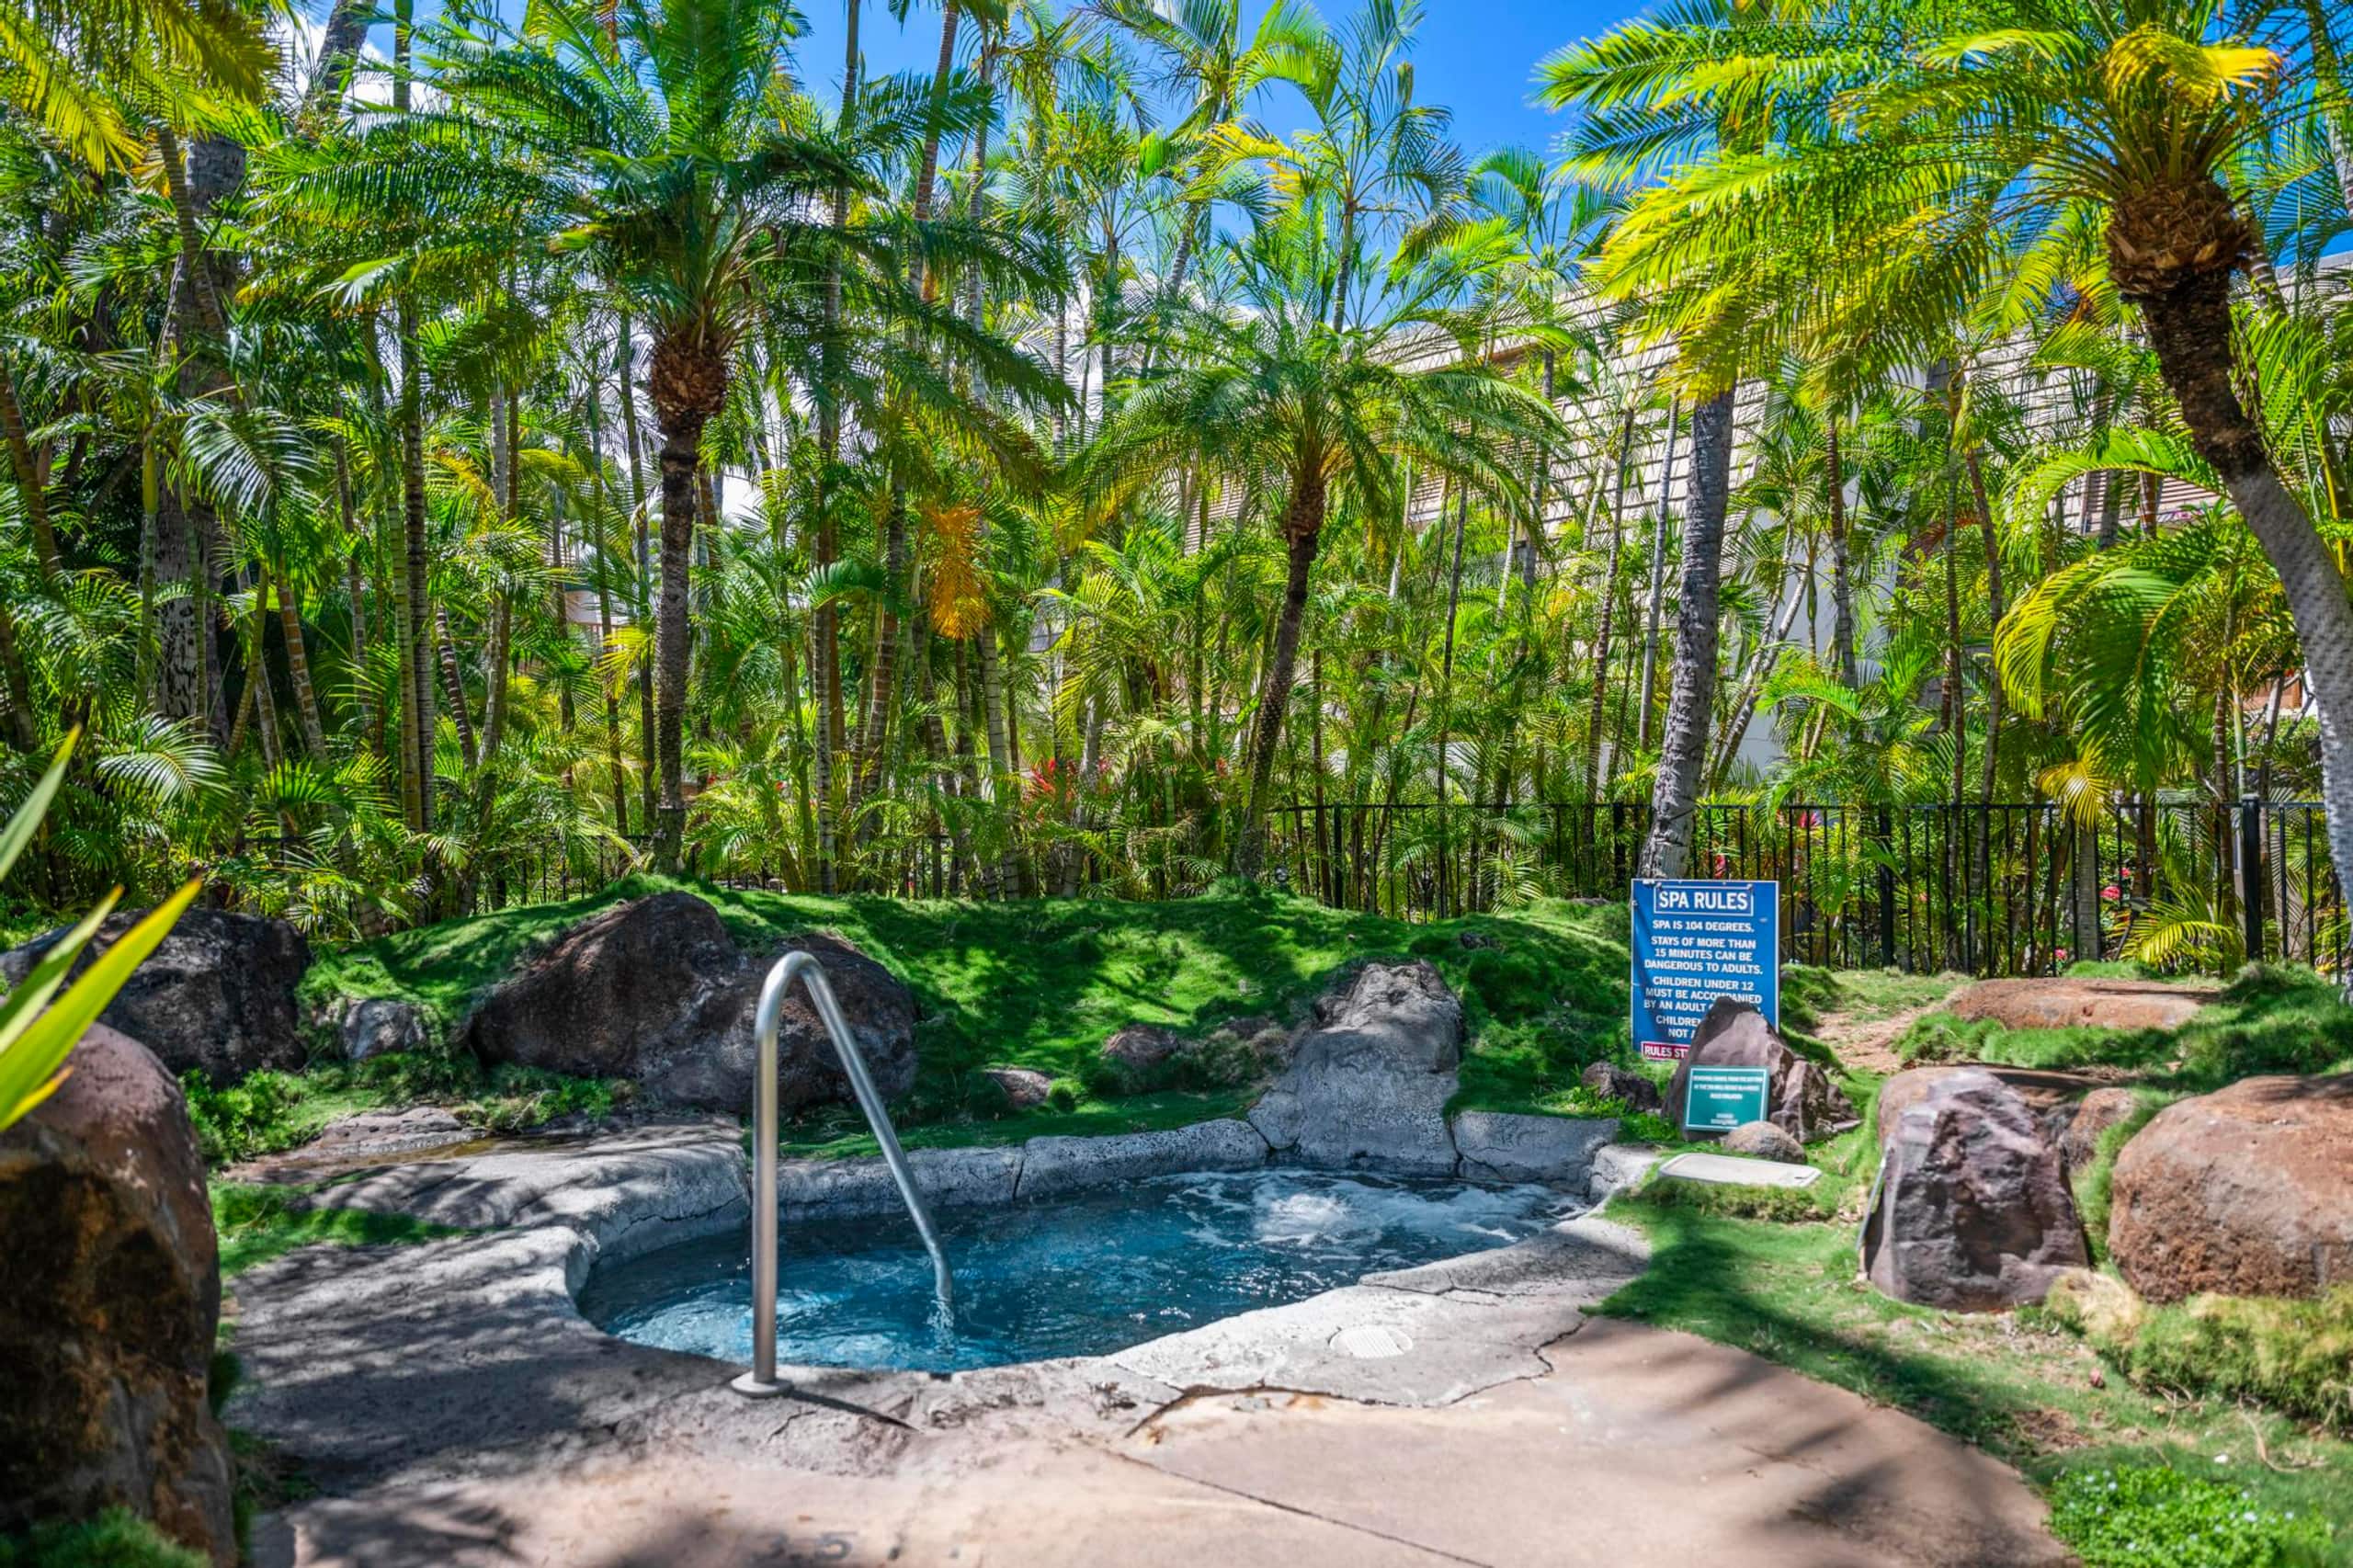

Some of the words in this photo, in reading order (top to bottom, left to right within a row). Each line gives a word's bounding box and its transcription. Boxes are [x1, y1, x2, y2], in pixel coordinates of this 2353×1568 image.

[1659, 892, 1689, 908] SPA
[1694, 892, 1747, 910] RULES
[1653, 920, 1671, 930] SPA
[1673, 921, 1683, 930] IS
[1686, 921, 1701, 930] 104
[1705, 922, 1755, 933] DEGREES.
[1651, 936, 1679, 947] STAYS
[1682, 937, 1694, 947] OF
[1697, 937, 1726, 948] MORE
[1729, 938, 1756, 949] THAN
[1655, 949, 1666, 958] 15
[1669, 949, 1712, 960] MINUTES
[1715, 950, 1736, 960] CAN
[1739, 951, 1753, 961] BE
[1644, 959, 1703, 971] DANGEROUS
[1707, 961, 1720, 972] TO
[1722, 962, 1763, 974] ADULTS.
[1653, 976, 1701, 987] CHILDREN
[1704, 979, 1738, 990] UNDER
[1742, 981, 1754, 992] 12
[1645, 987, 1673, 998] MUST
[1676, 989, 1688, 999] BE
[1643, 999, 1656, 1008] BY
[1659, 1000, 1673, 1010] AN
[1675, 1001, 1706, 1012] ADULT
[1668, 1028, 1688, 1039] NOT
[1644, 1044, 1672, 1057] RULES
